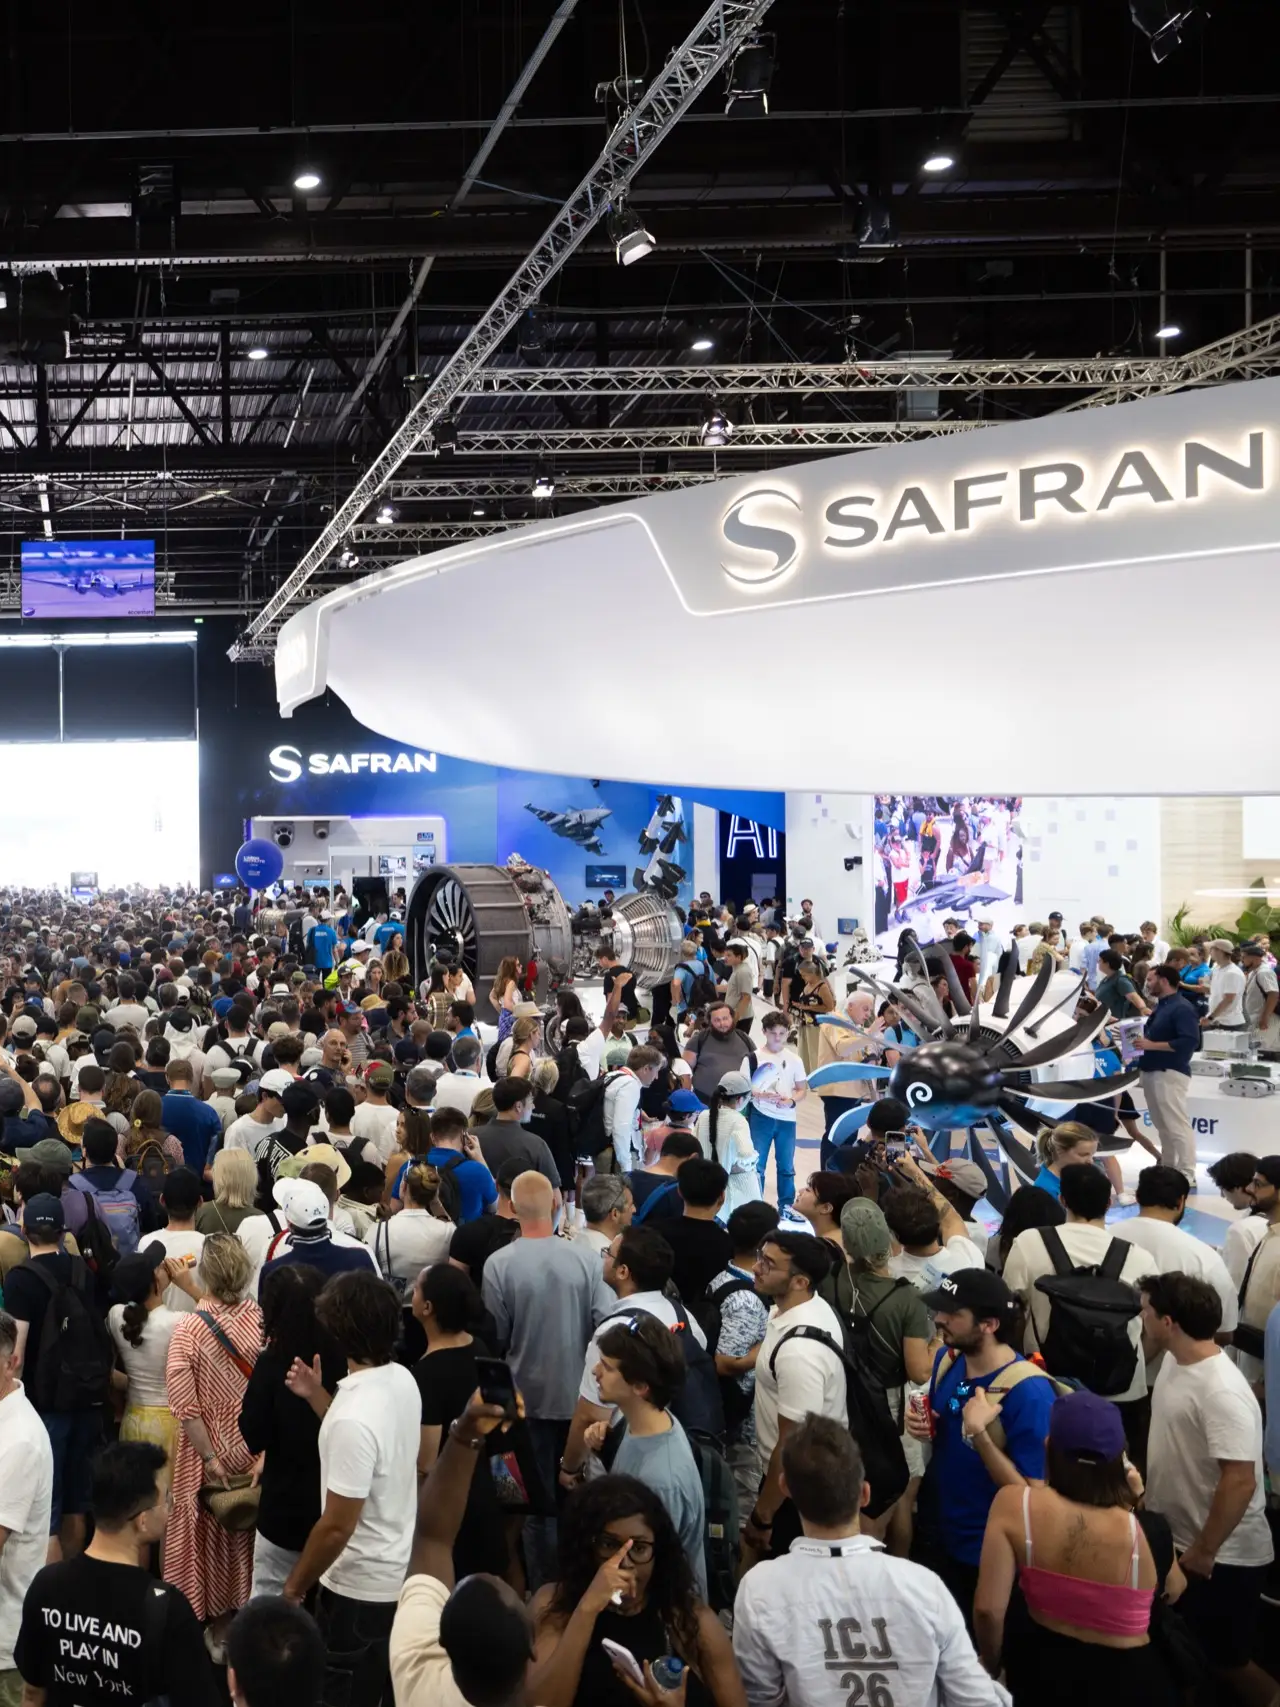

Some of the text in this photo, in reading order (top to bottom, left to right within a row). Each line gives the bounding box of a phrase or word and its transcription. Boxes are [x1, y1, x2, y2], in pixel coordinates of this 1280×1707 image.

[824, 431, 1265, 549] SAFRAN
[308, 751, 438, 775] SAFRAN
[41, 1607, 142, 1649] TO LIVE AND
[817, 1617, 893, 1661] ICJ
[59, 1638, 119, 1670] PLAY IN
[53, 1664, 134, 1696] New York
[839, 1672, 895, 1707] 26
